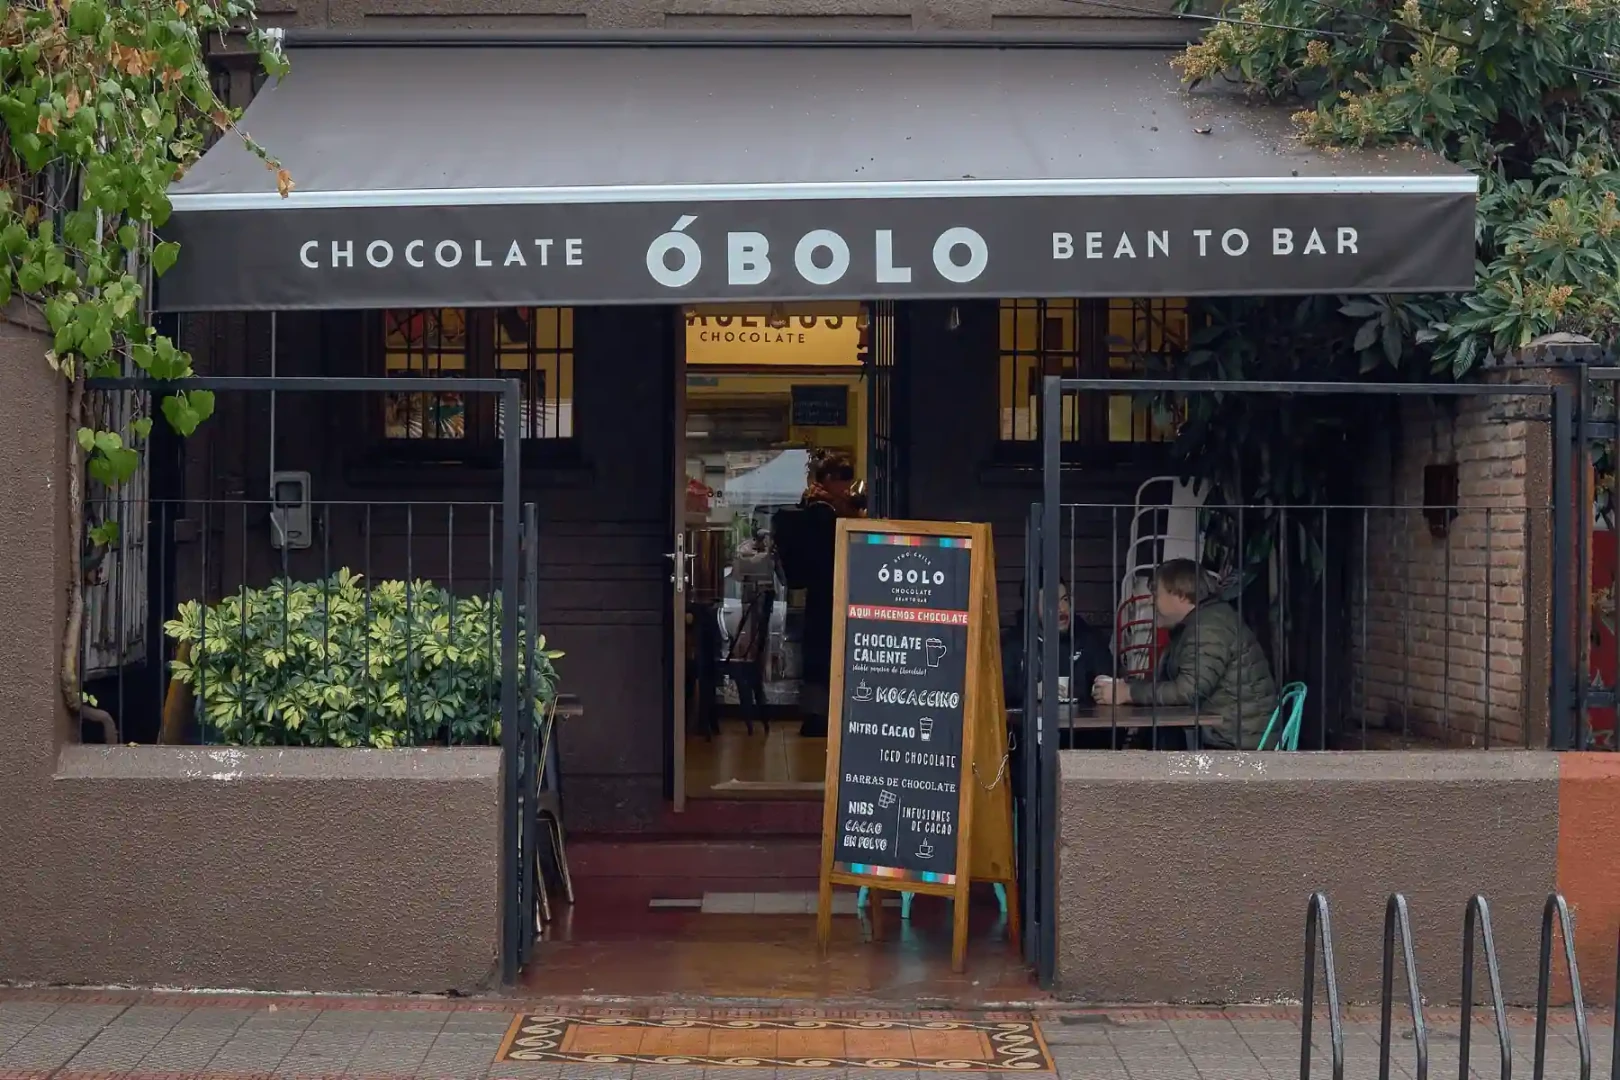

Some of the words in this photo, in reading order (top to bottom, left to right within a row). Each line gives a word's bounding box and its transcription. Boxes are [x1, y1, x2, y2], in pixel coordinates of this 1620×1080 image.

[646, 214, 988, 288] ÓBOLO
[1052, 230, 1168, 259] BEAN
[1193, 228, 1248, 256] TO
[1272, 227, 1358, 255] BAR
[300, 238, 582, 268] CHOCOLATE
[700, 332, 805, 343] CHOCOLATE
[878, 564, 944, 585] ÓBOLO
[892, 588, 932, 596] CHOCOLATE
[850, 606, 870, 617] AQUI
[874, 609, 915, 620] HACEMOS
[918, 612, 967, 624] CHOCOLATE
[854, 633, 922, 650] CHOCOLATE
[854, 649, 907, 664] CALIENTE
[876, 686, 960, 708] MOCACCINO
[849, 721, 878, 735] NITRO
[881, 724, 915, 738] CACAO
[880, 749, 900, 762] ICED
[905, 752, 956, 768] CHOCOLATE
[846, 773, 884, 785] BARRAS
[887, 778, 898, 787] DE
[902, 779, 956, 792] CHOCOLATE
[849, 801, 874, 815] NIBS
[902, 807, 950, 822] INFUSIONES
[845, 820, 882, 834] CACAO
[911, 821, 921, 832] DE
[925, 822, 952, 835] CACAO
[858, 836, 887, 851] POLVO
